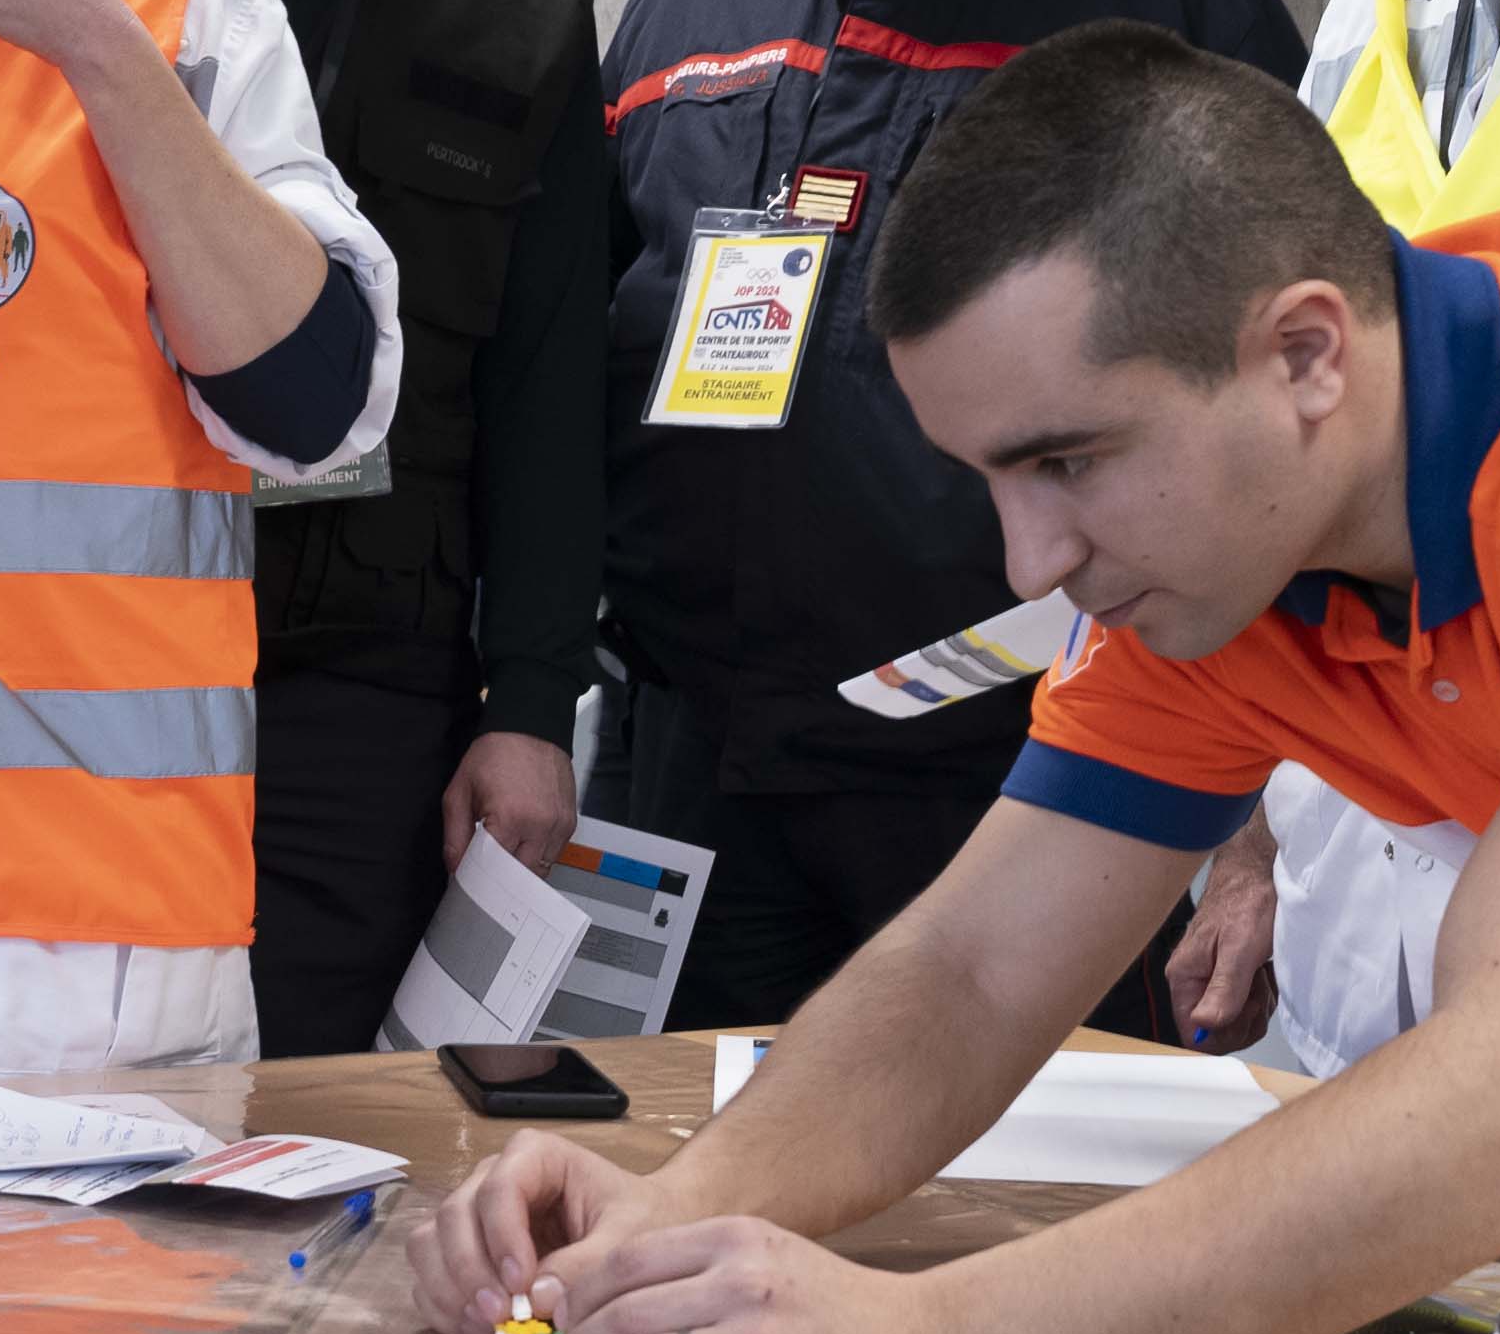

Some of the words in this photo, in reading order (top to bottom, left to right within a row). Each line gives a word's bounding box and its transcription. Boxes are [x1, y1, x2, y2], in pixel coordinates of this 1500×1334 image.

[734, 286, 754, 297] JOP
[755, 285, 781, 297] 2024
[696, 335, 729, 345] CENTRE
[730, 335, 741, 345] DE
[742, 335, 756, 345] TIR
[757, 336, 792, 346] SPORTIF
[710, 349, 771, 359] CHATEAUROUX
[702, 379, 763, 390] STAGIAIRE
[684, 389, 774, 400] ENTRAINEMENT
